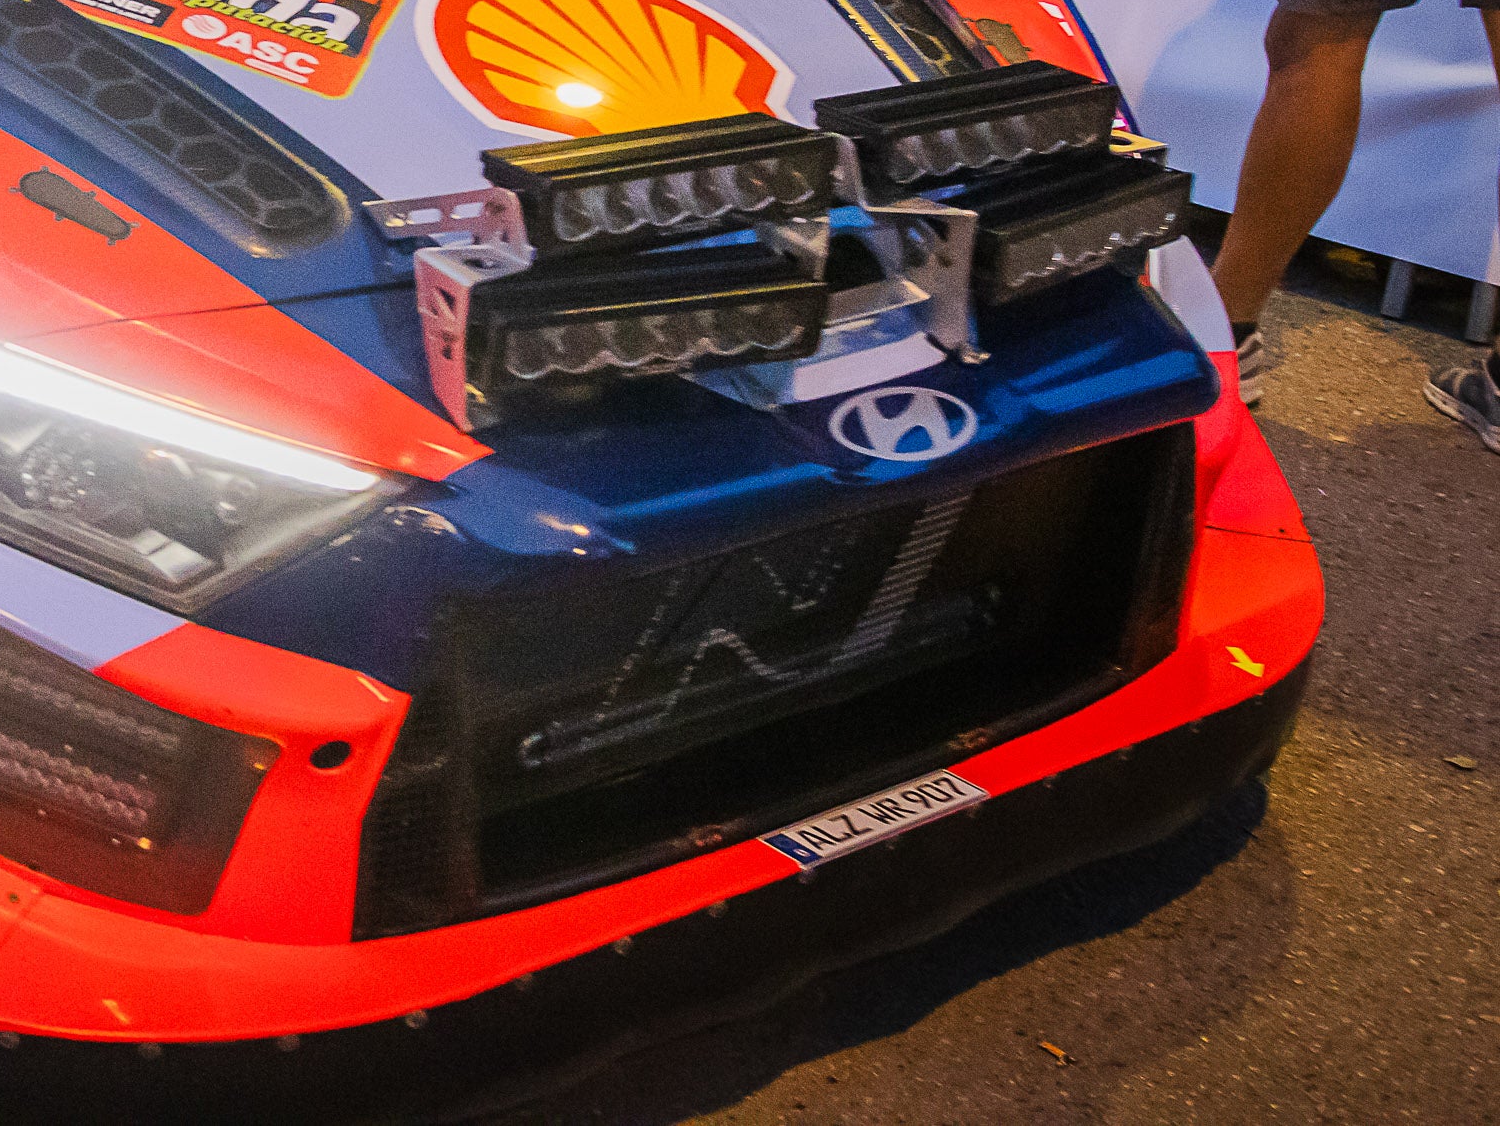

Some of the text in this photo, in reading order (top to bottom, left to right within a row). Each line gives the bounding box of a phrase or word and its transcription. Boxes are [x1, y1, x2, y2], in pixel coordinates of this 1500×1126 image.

[216, 31, 320, 74] ASC
[797, 776, 968, 851] ALZ WR 907
